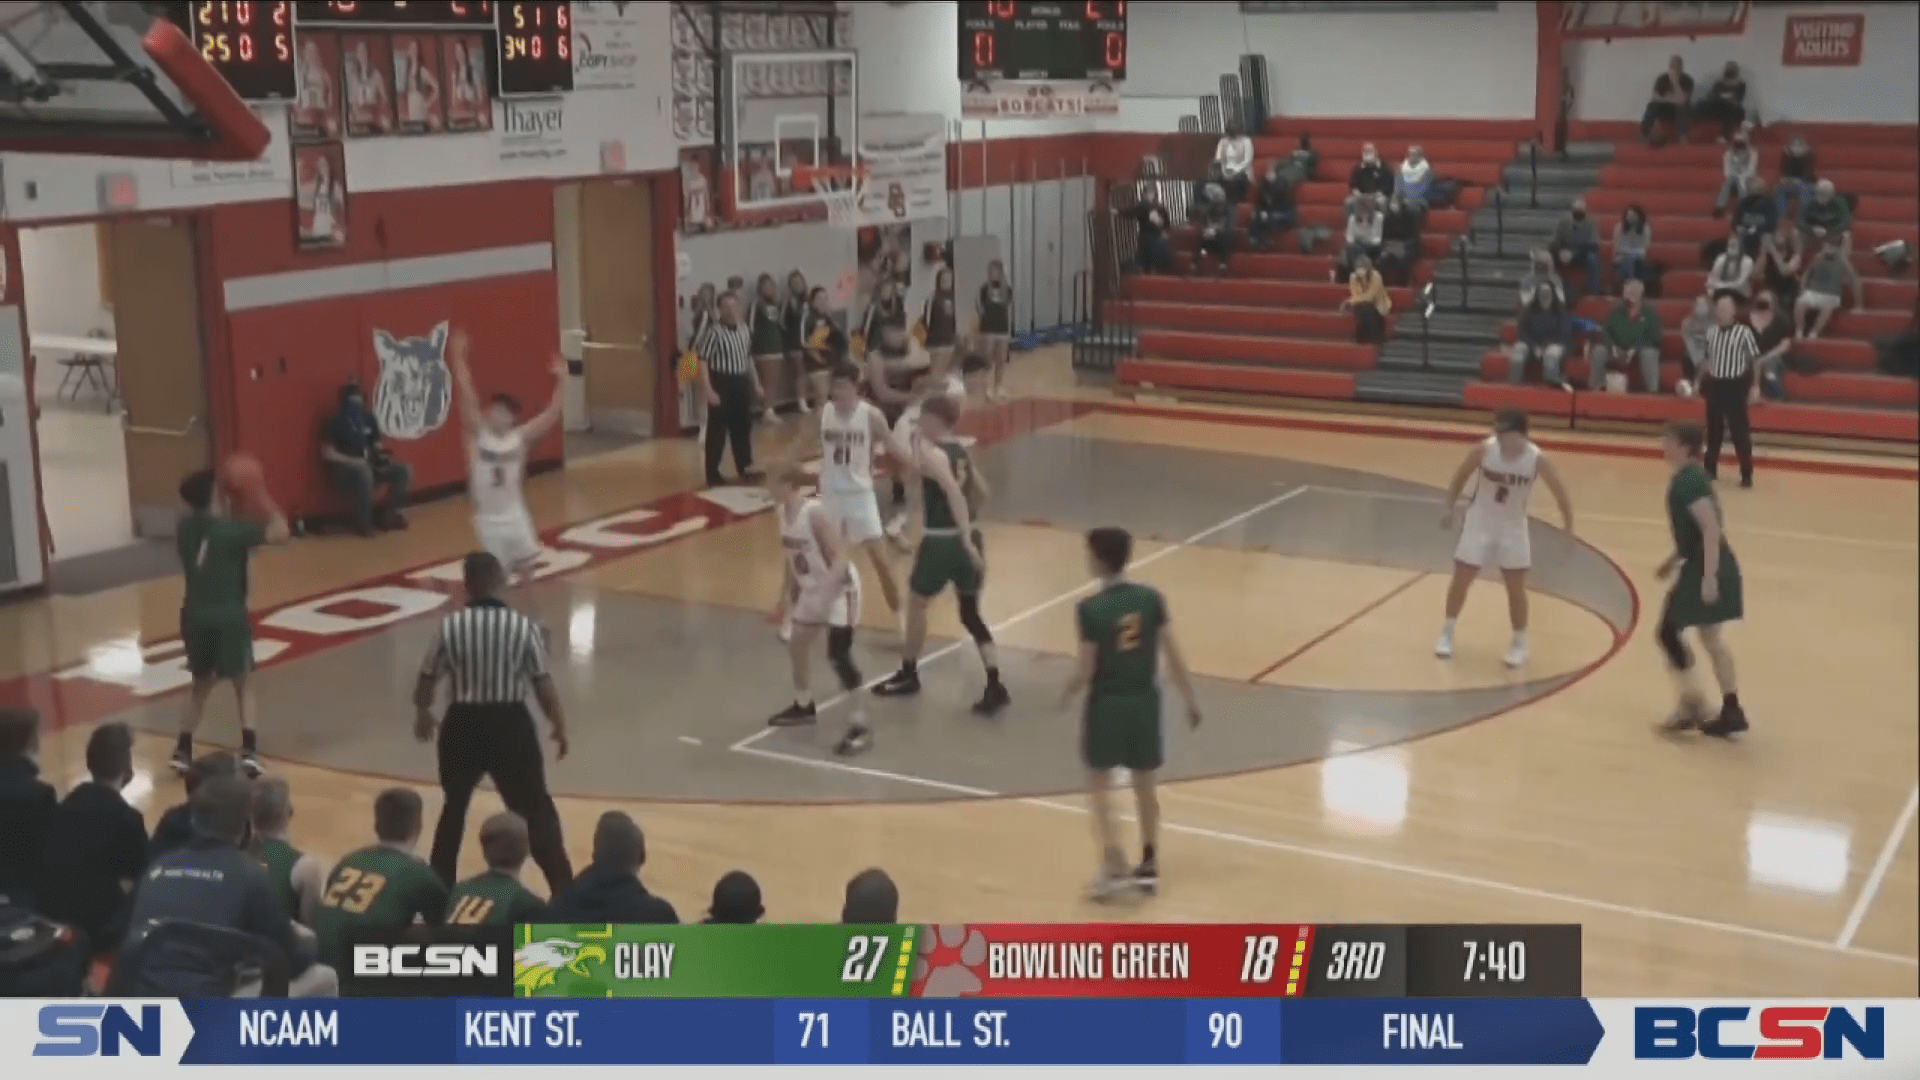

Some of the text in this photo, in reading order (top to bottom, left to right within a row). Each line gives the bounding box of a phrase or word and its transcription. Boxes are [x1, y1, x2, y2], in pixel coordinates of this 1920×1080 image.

[202, 33, 231, 62] 25
[274, 34, 289, 61] 5
[504, 35, 527, 60] 34
[1117, 612, 1142, 652] 2
[323, 866, 388, 914] 23
